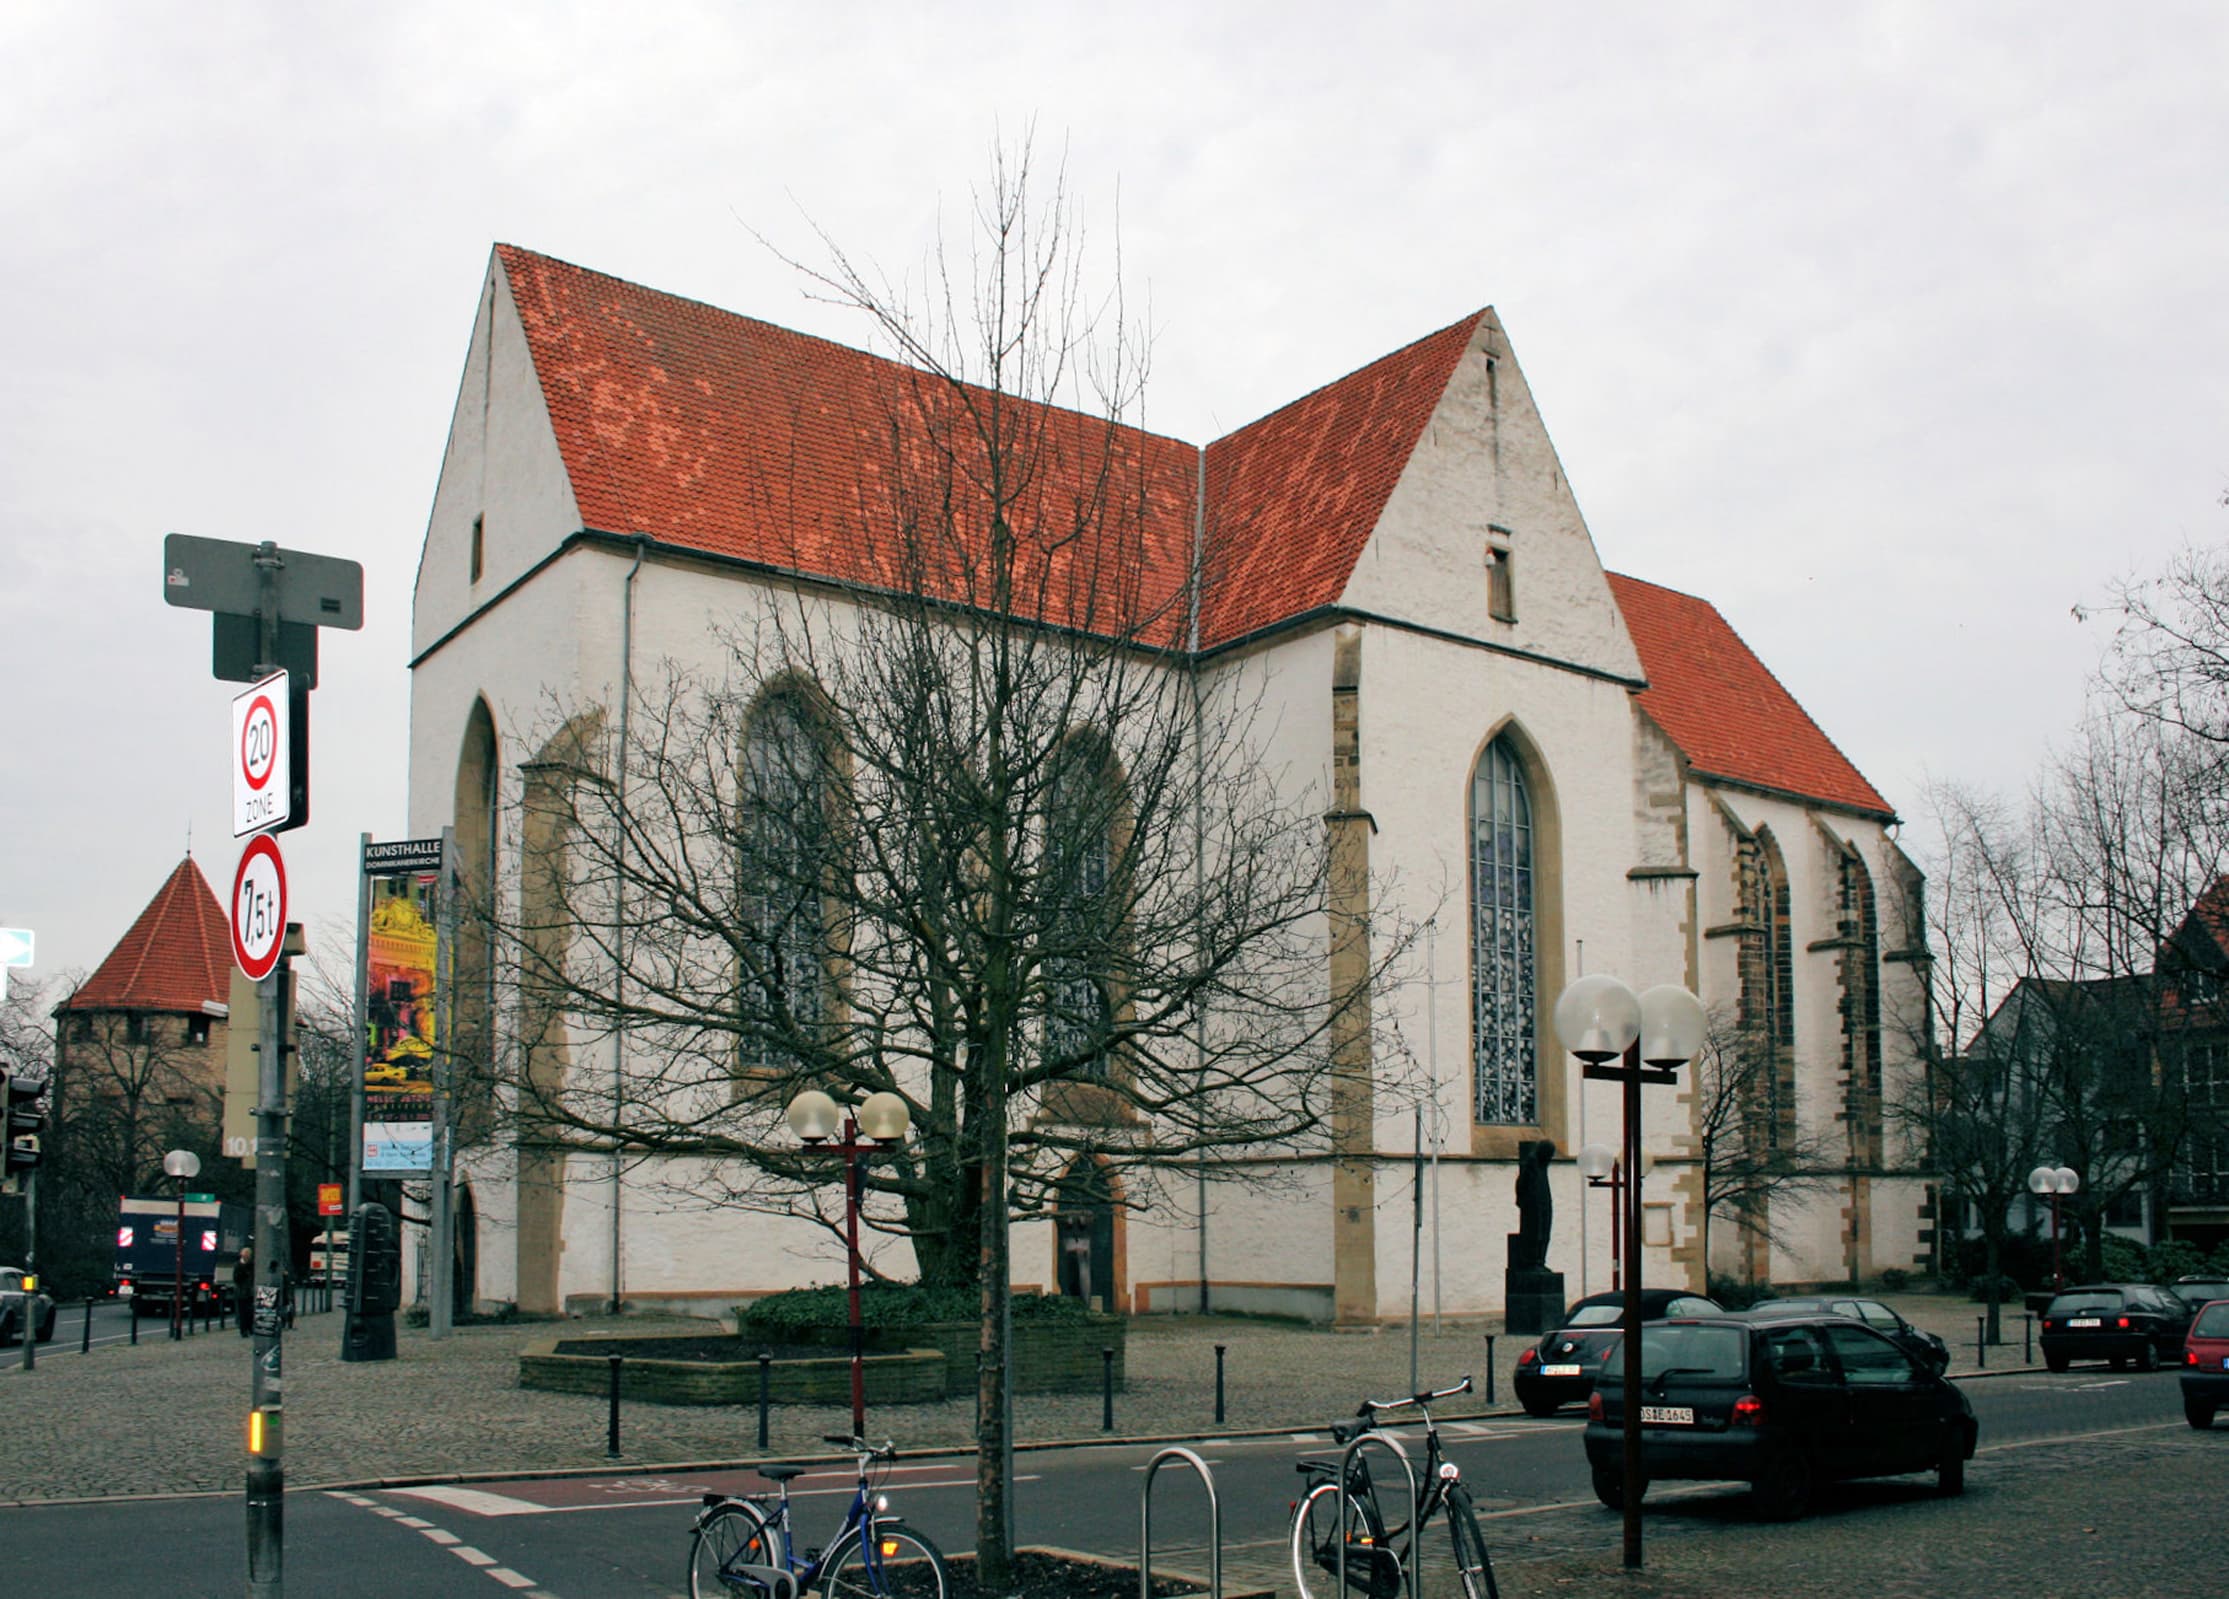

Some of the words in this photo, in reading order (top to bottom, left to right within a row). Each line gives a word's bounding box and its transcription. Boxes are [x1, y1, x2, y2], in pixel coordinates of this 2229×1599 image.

[249, 719, 270, 767] 20
[246, 792, 274, 823] ZONE
[366, 841, 441, 858] KUNSTHALLE
